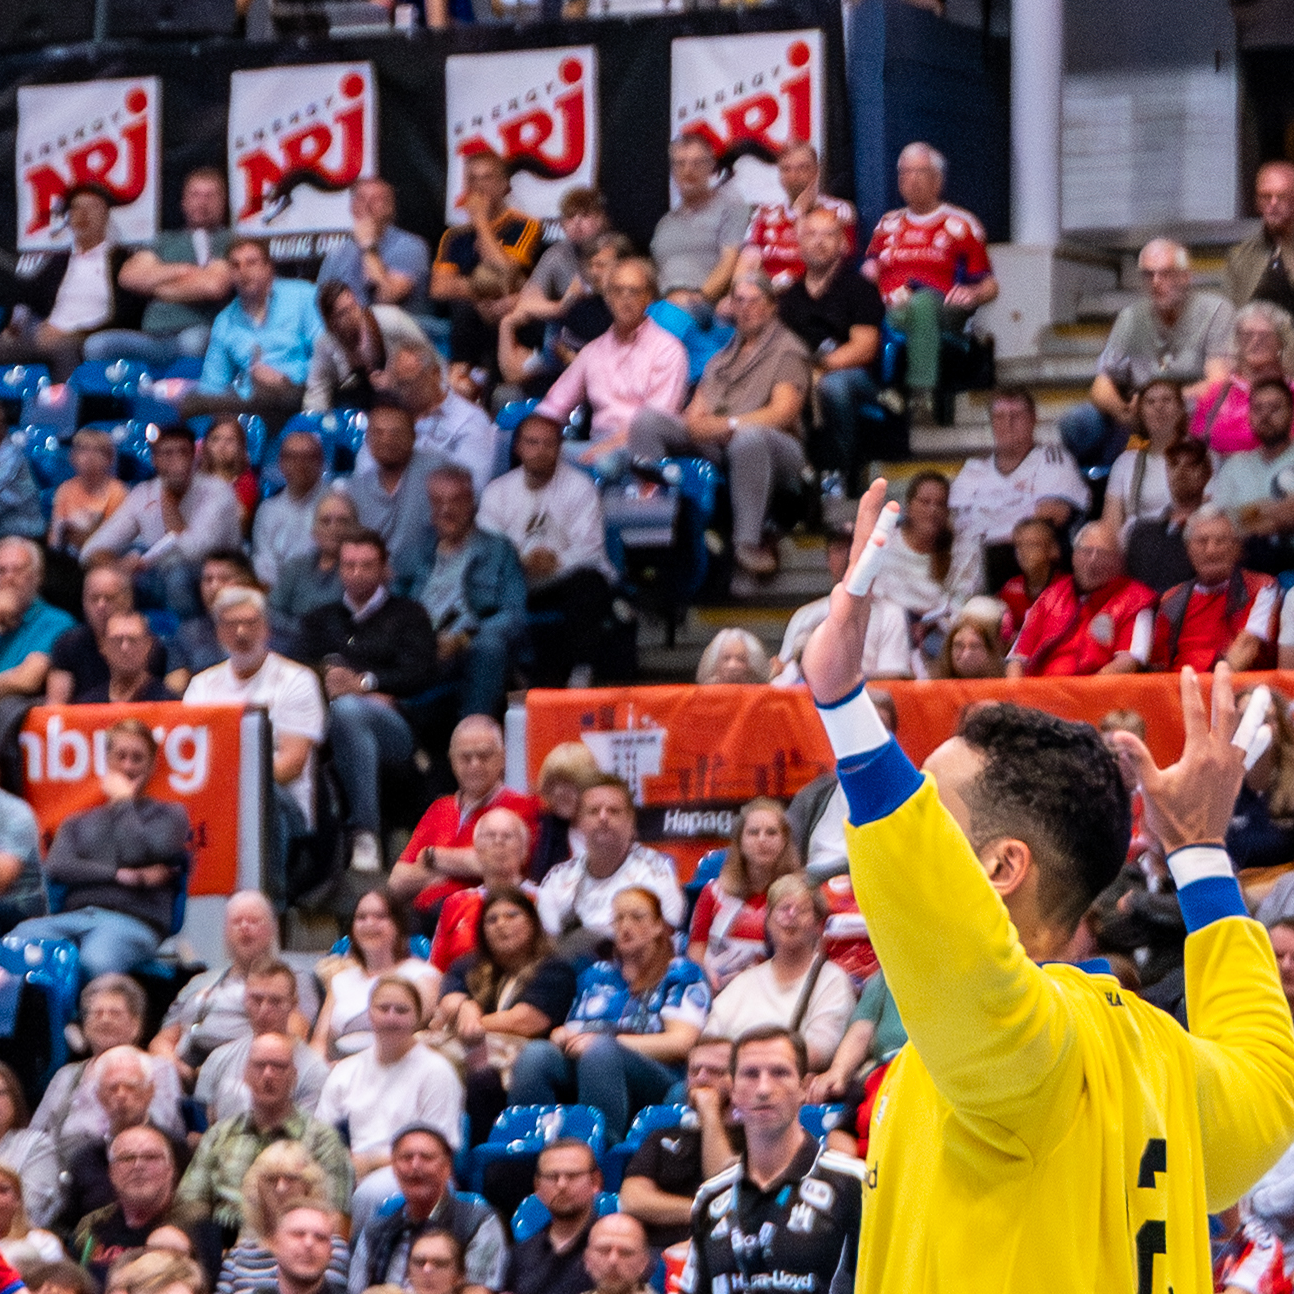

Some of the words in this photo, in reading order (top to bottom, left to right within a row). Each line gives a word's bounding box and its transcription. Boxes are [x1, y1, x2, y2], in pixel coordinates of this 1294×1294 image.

[454, 81, 557, 136] ENERGY
[677, 65, 780, 121] ENERGY
[235, 95, 336, 149] ENERGY
[237, 72, 365, 223] NRJ
[25, 86, 149, 236] NRJ
